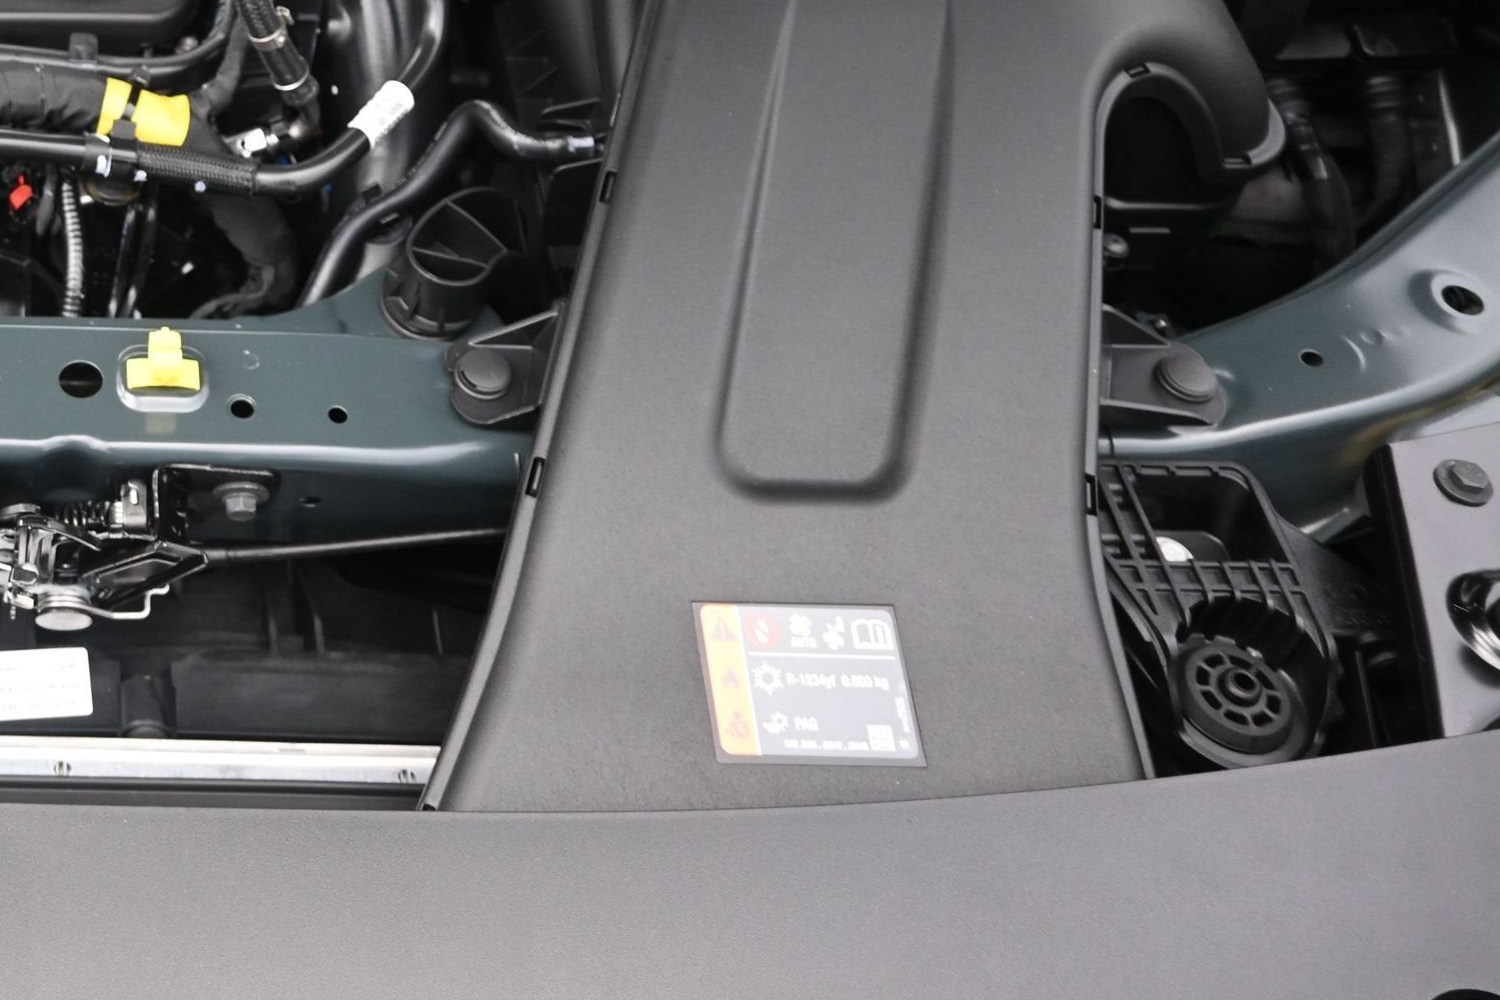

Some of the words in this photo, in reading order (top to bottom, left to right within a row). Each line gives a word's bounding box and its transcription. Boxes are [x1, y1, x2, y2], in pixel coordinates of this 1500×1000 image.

[790, 635, 817, 648] AUTO
[786, 672, 836, 690] R-1234yf
[873, 674, 890, 691] kg
[794, 716, 819, 732] PAG
